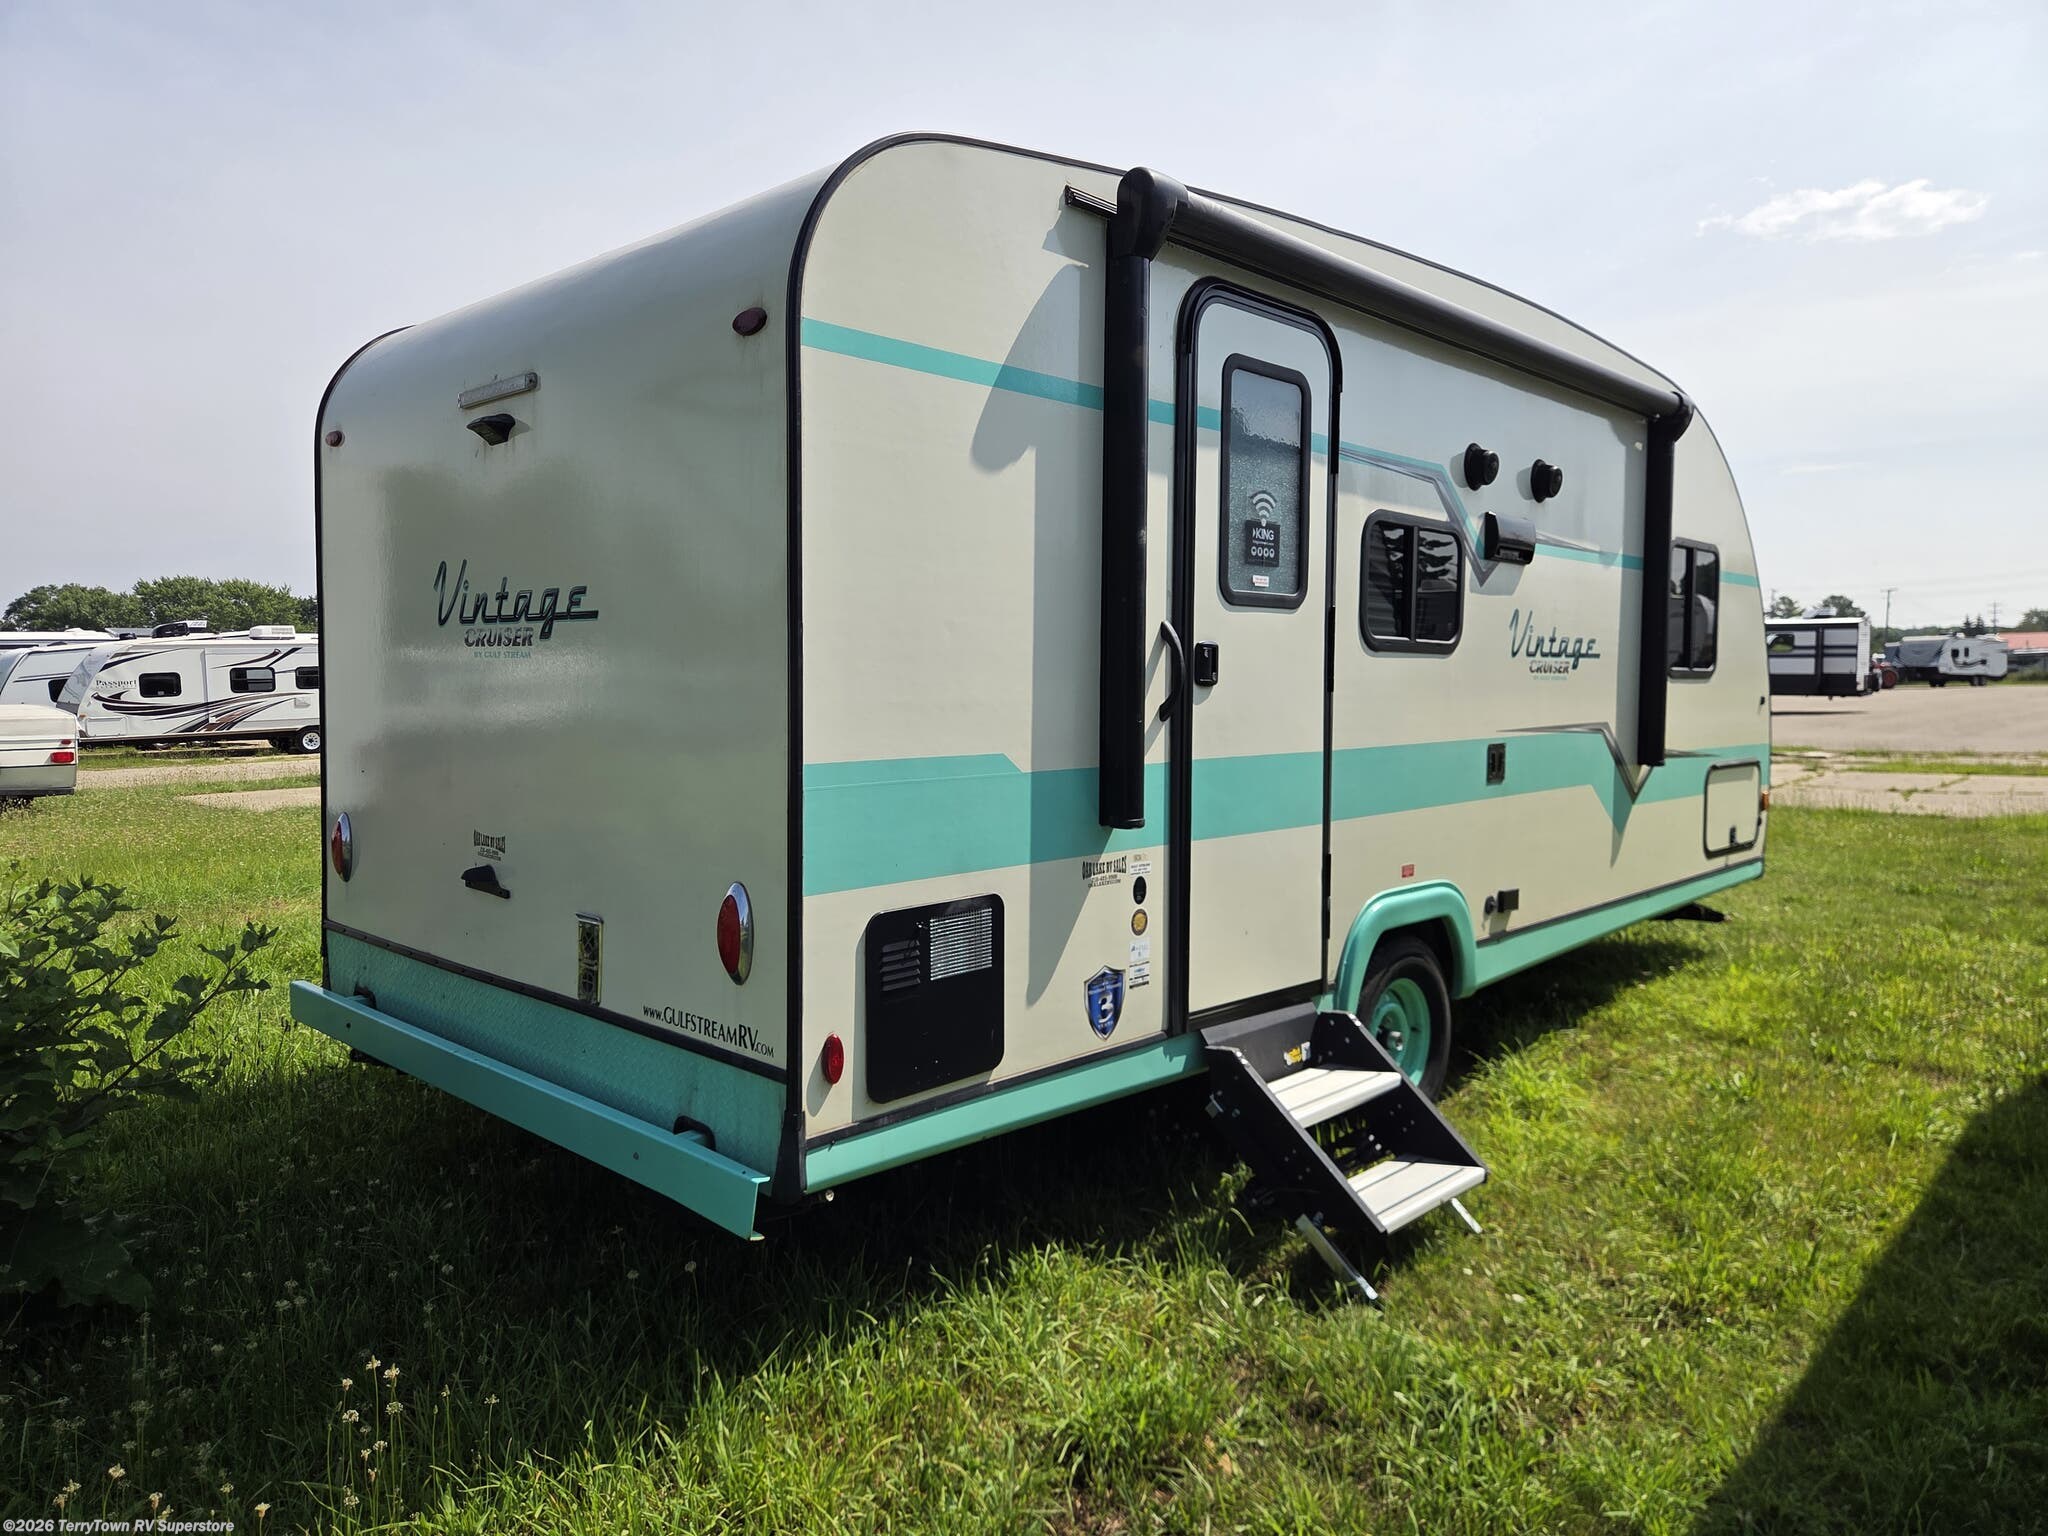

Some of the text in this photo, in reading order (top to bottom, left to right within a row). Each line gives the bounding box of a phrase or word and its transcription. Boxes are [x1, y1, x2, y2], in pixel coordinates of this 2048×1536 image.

[433, 558, 599, 640] Vintage
[464, 627, 534, 647] CRUISER
[1509, 608, 1601, 670] Vintage
[1529, 660, 1570, 674] CRUISER
[95, 679, 137, 688] Passport
[1098, 991, 1114, 1024] 3
